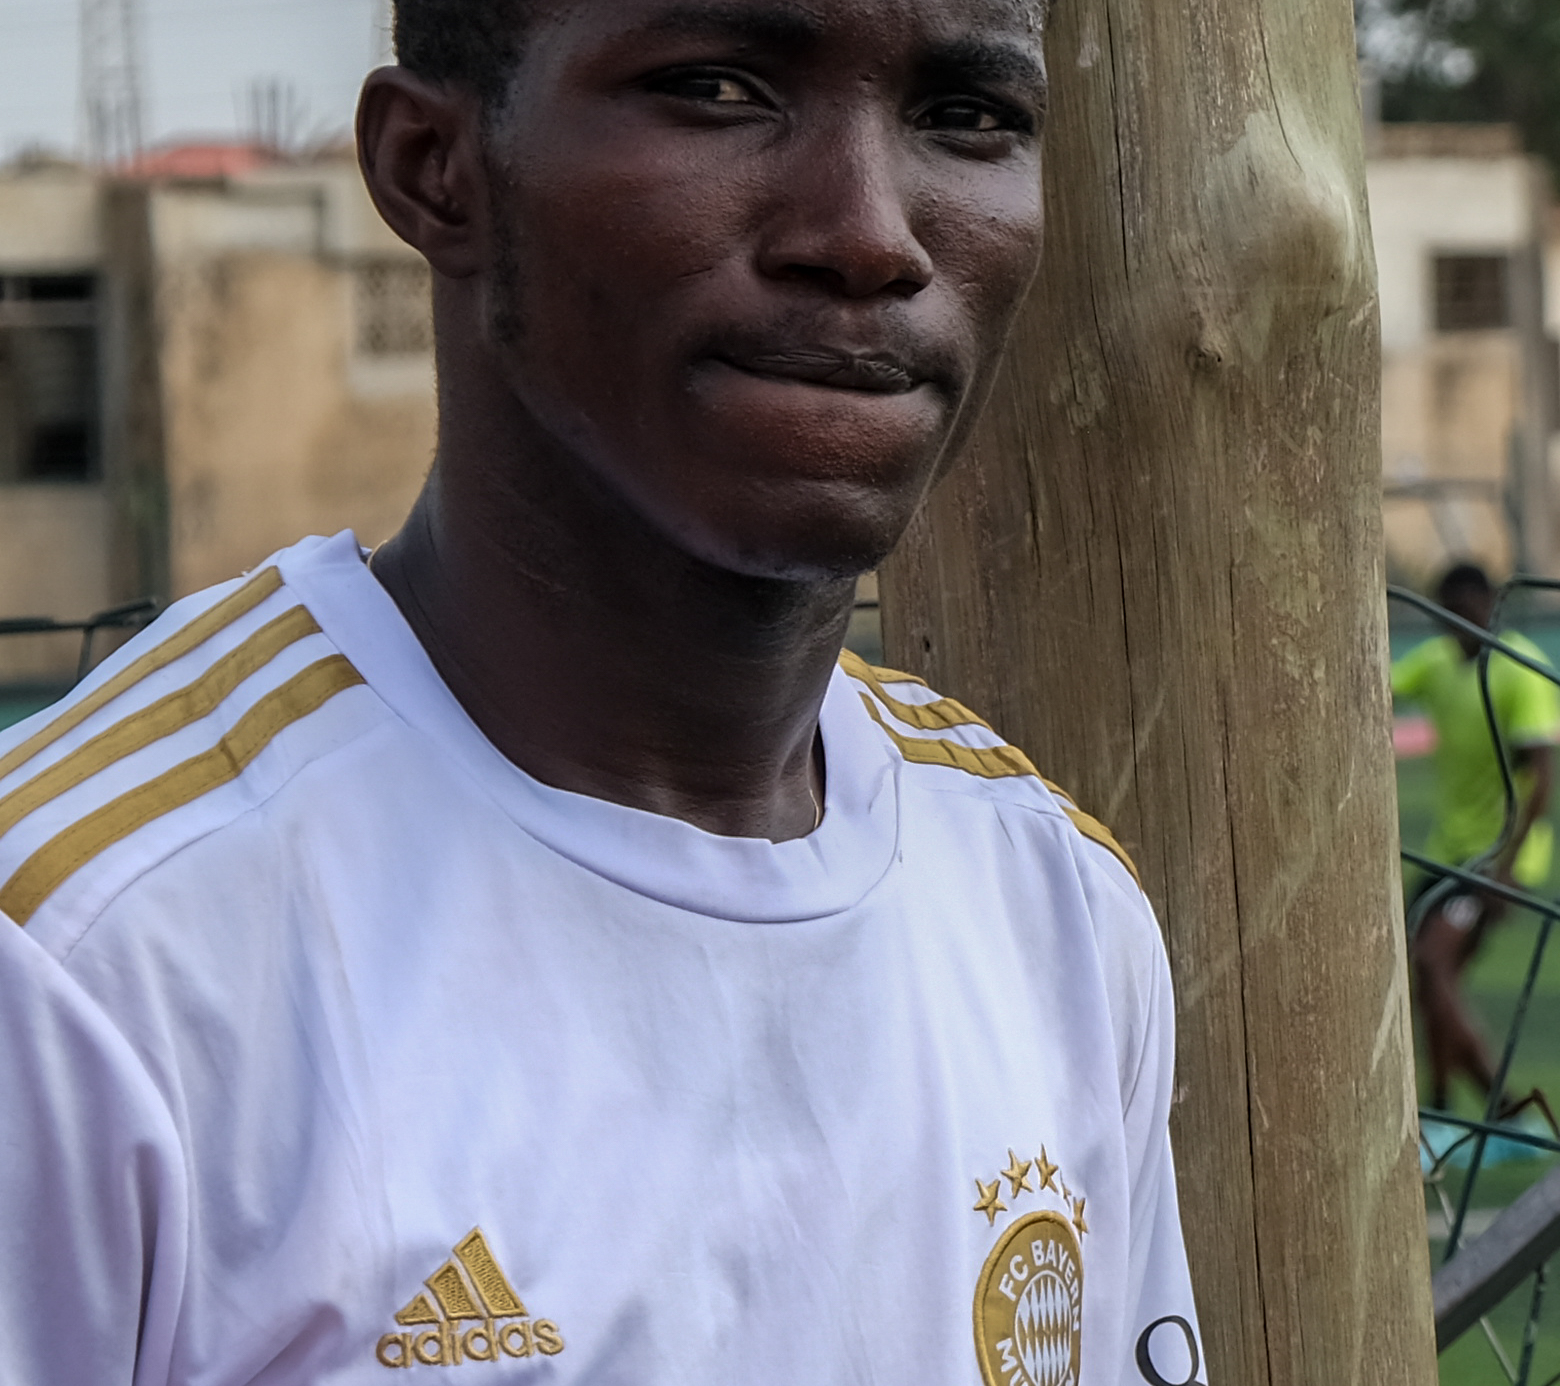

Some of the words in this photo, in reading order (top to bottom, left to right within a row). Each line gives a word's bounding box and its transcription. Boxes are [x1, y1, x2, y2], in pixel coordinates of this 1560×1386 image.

[998, 1254, 1029, 1302] FC
[1031, 1239, 1080, 1332] BAYERN
[375, 1317, 565, 1369] adidas
